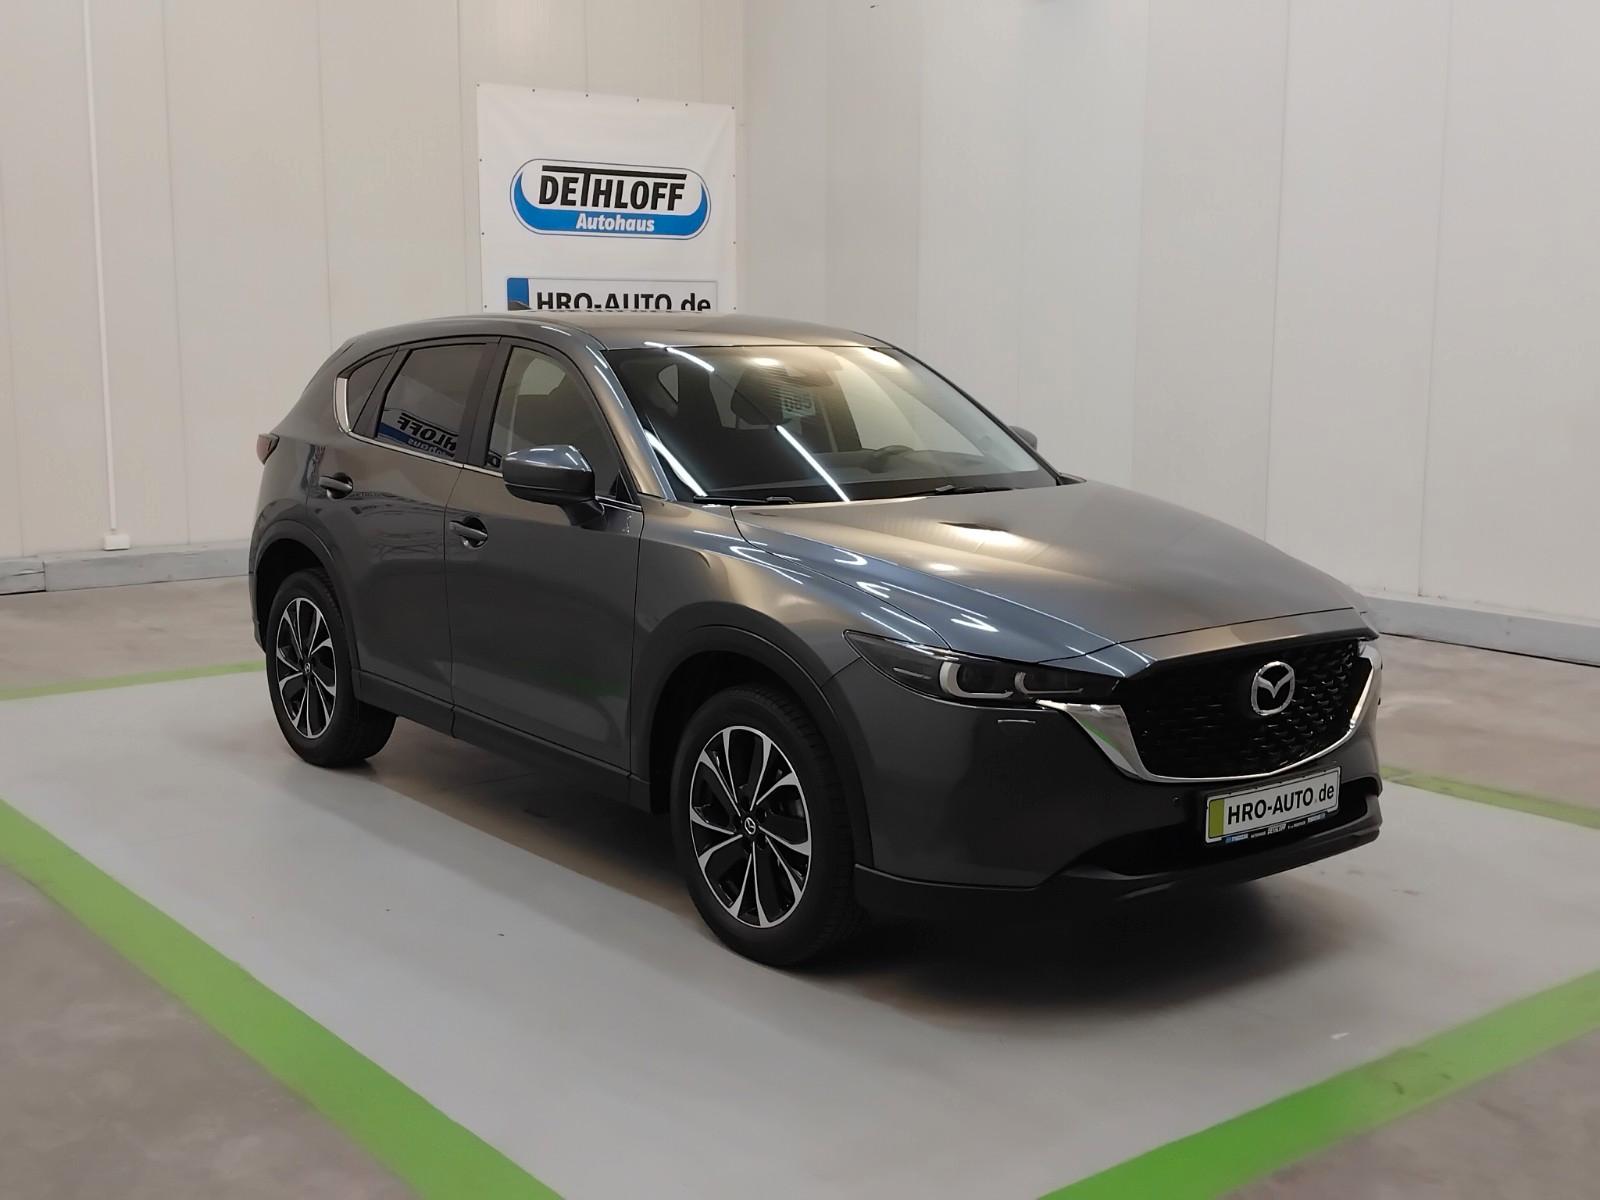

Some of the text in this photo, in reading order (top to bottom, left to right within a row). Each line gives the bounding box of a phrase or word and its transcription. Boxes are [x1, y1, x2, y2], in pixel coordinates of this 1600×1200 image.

[538, 165, 688, 211] DETHLOFF
[576, 213, 655, 232] Autohaus
[536, 291, 711, 312] HRO-AUTOde
